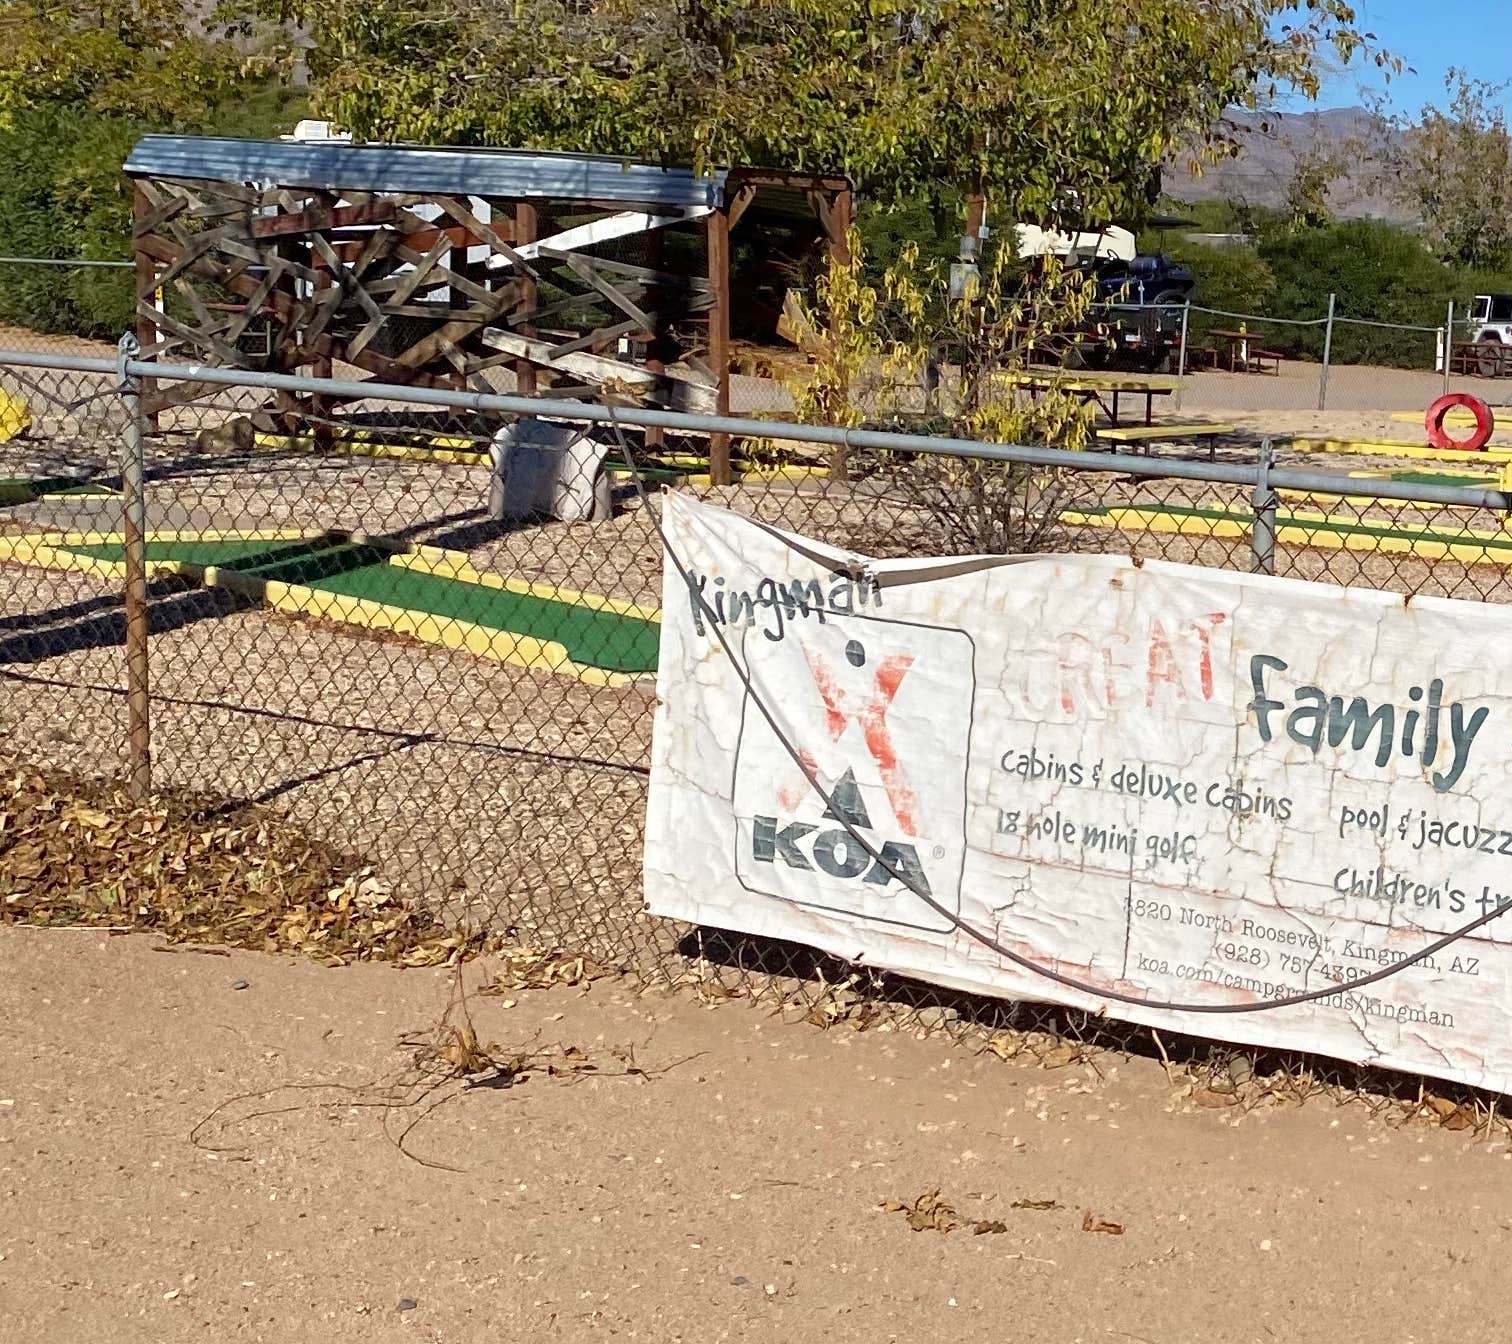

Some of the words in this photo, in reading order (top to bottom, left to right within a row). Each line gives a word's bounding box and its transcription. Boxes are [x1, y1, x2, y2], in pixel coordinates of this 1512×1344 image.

[688, 569, 883, 641] Kingman
[1003, 612, 1227, 715] REAT
[1110, 764, 1198, 807] deluxe
[1025, 810, 1076, 844] hole
[1082, 824, 1138, 855] mini
[1145, 831, 1198, 868] golf
[1340, 803, 1388, 840] pool
[752, 814, 933, 896] KOA
[1179, 906, 1234, 933] North
[1242, 918, 1336, 957] Roosevelt,
[1341, 938, 1442, 974] Kingmn,
[1448, 955, 1480, 976] AZ
[1215, 942, 1271, 969] (928)
